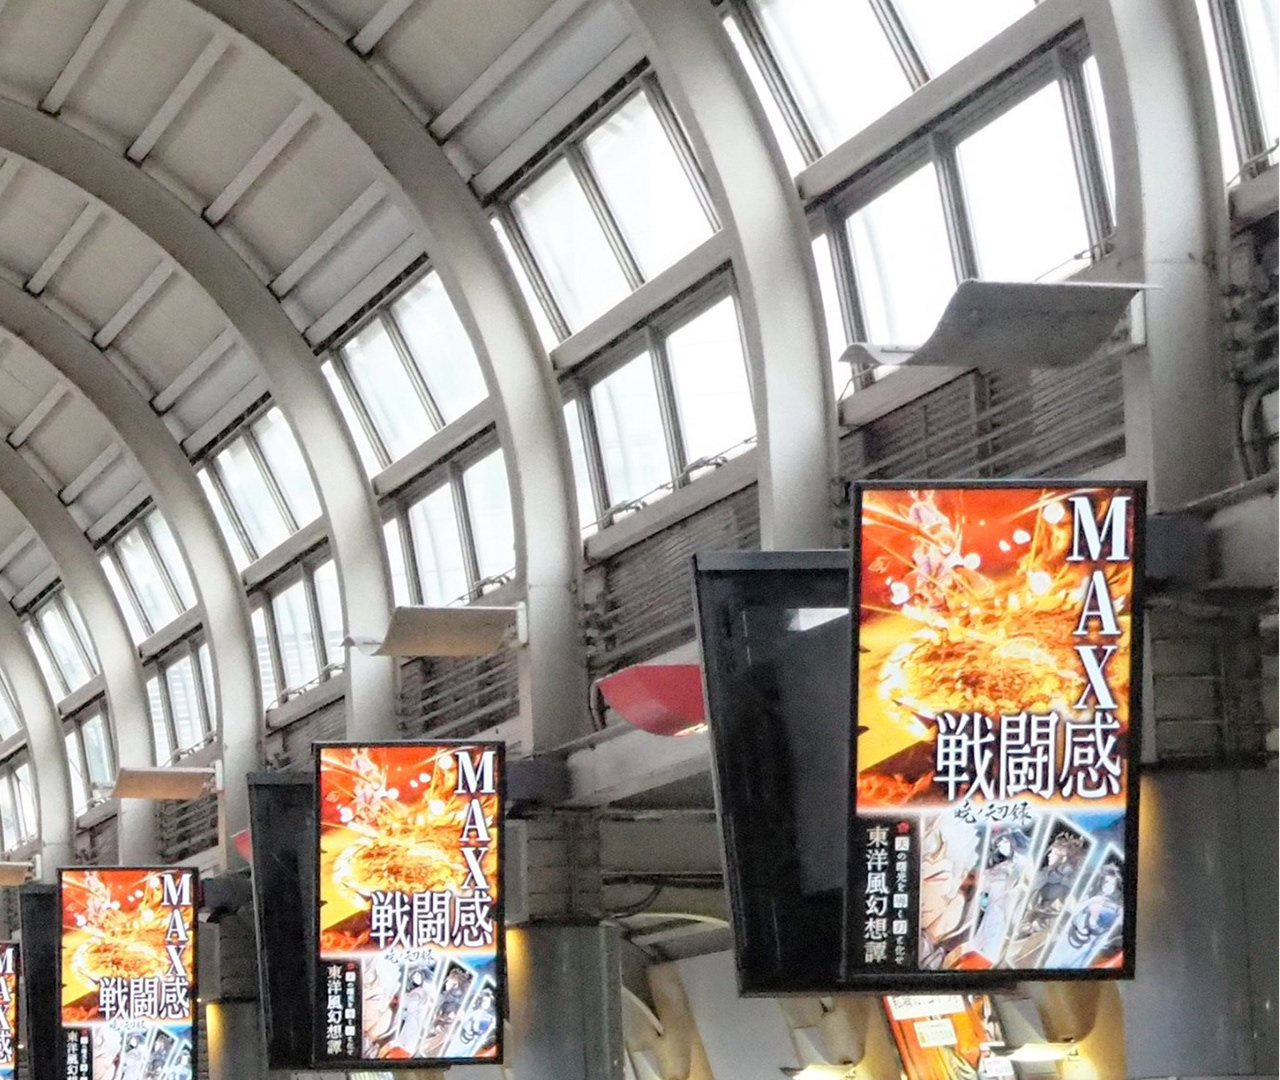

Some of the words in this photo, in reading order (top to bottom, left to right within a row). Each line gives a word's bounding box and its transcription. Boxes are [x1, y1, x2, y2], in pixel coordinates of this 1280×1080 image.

[1067, 496, 1131, 710] MAX
[933, 712, 1122, 801] 戦闘感
[454, 751, 496, 890] MAX
[162, 874, 191, 977] MAX
[370, 890, 493, 949] 戦闘感
[864, 826, 889, 963] 東洋風幻想譚
[98, 976, 189, 1019] 戦闘感
